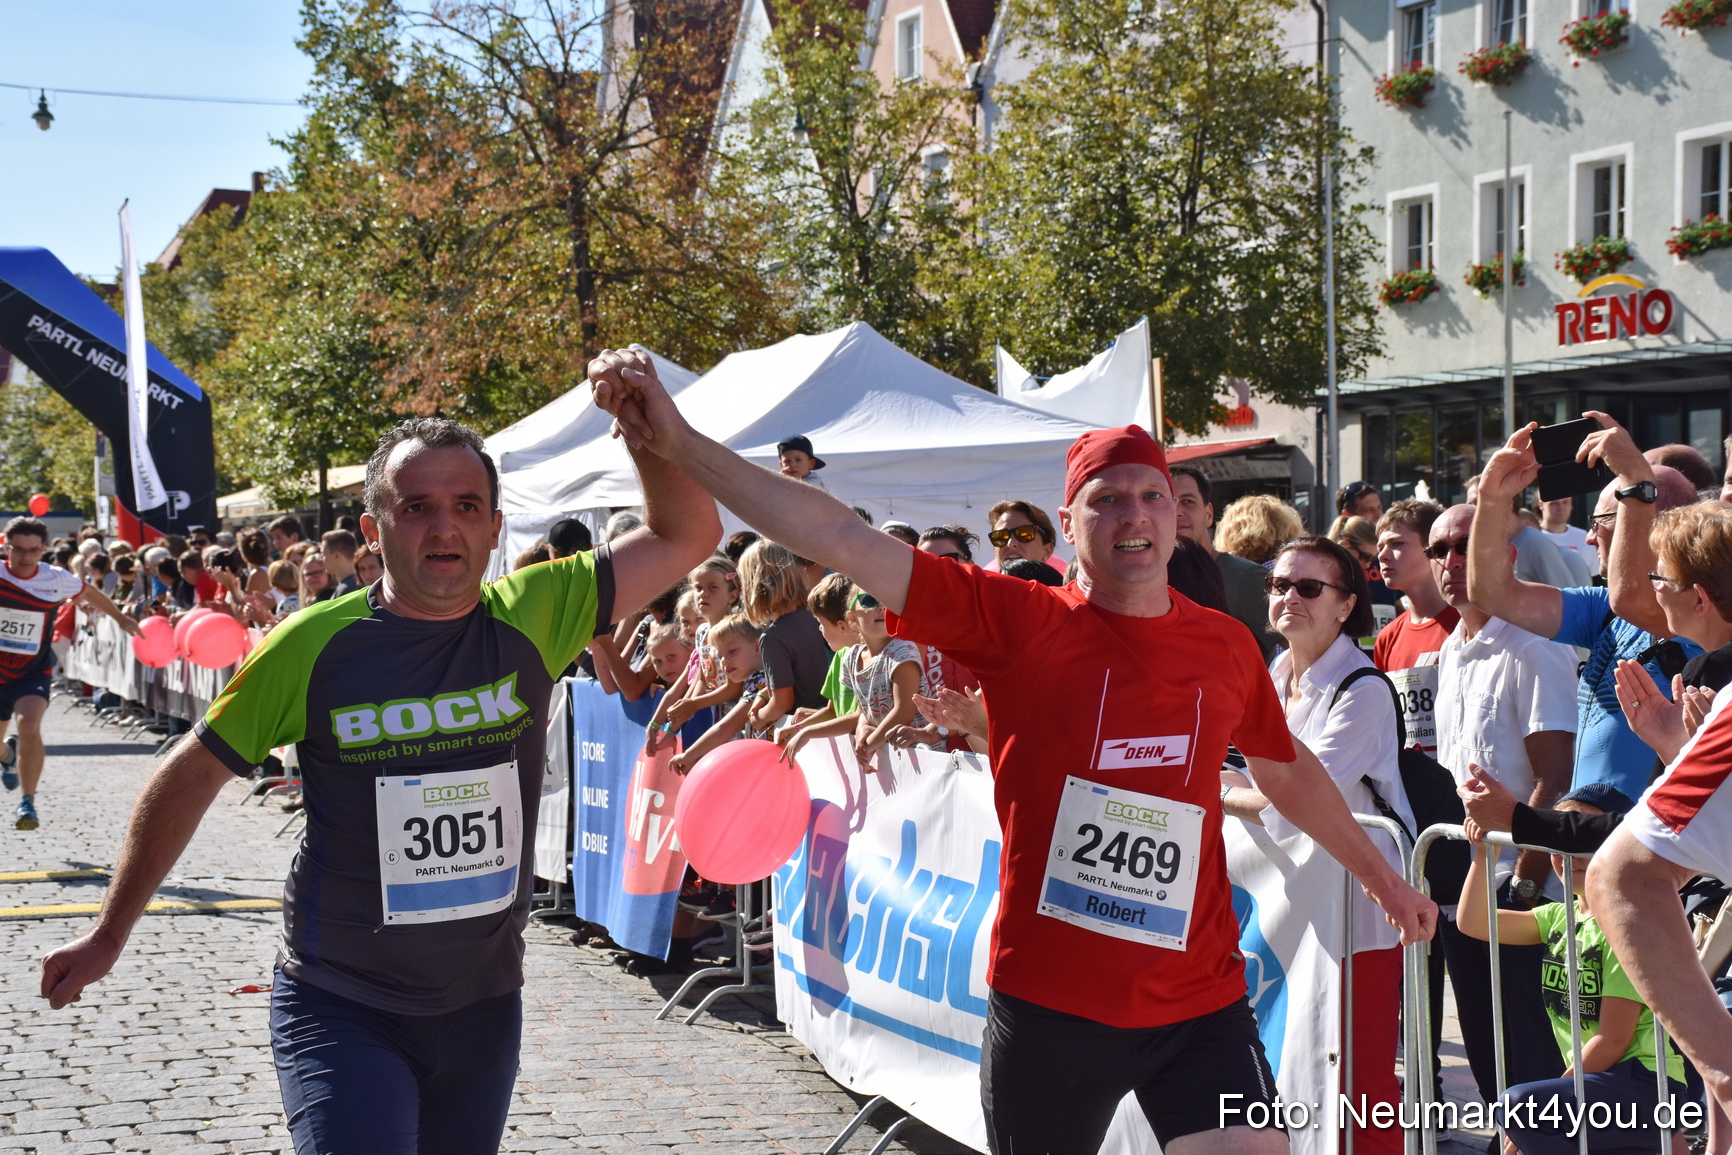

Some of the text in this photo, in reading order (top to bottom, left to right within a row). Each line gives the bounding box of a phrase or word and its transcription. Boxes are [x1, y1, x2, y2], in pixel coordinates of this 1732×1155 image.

[1555, 288, 1673, 346] RENO
[27, 314, 83, 357] PARTL
[137, 461, 157, 500] PARTL
[1, 620, 36, 636] 2517
[330, 671, 530, 749] BOCK
[339, 716, 534, 764] inspired by smart concepts
[582, 741, 605, 762] STORE
[1123, 745, 1166, 760] DEHN
[423, 781, 490, 803] BOCK
[470, 797, 491, 805] concepts
[582, 786, 609, 809] ONLINE
[1103, 815, 1124, 824] inspired
[1146, 824, 1168, 832] concepts
[1105, 800, 1169, 827] BOCK
[403, 806, 503, 861] 3051
[1071, 823, 1181, 884] 2469
[415, 859, 493, 877] PARTL Neumarkt
[1077, 872, 1153, 897] PARTL Neumarkt
[1085, 895, 1146, 925] Robert
